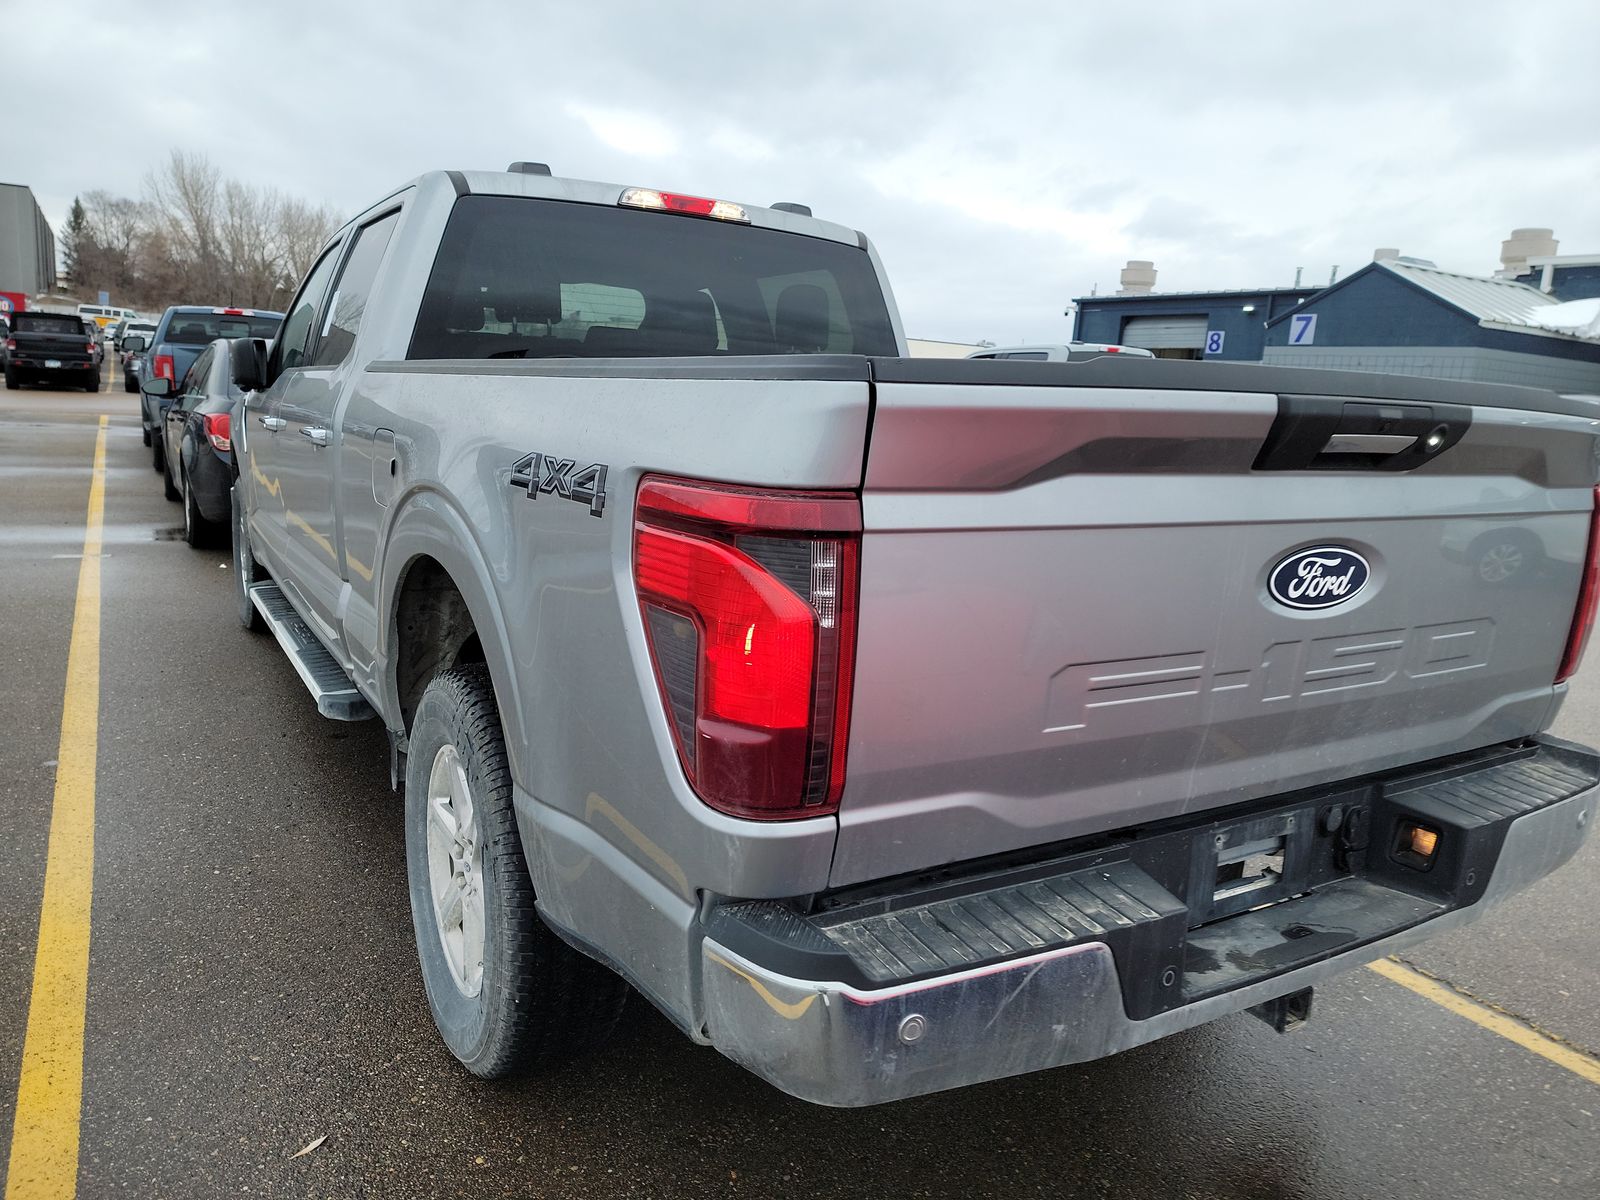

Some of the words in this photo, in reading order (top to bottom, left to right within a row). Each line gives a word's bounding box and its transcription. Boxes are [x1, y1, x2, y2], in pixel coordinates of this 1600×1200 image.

[1208, 332, 1221, 352] 8
[1294, 315, 1313, 343] 7
[1288, 557, 1356, 599] Ford
[1042, 616, 1497, 733] F-150
